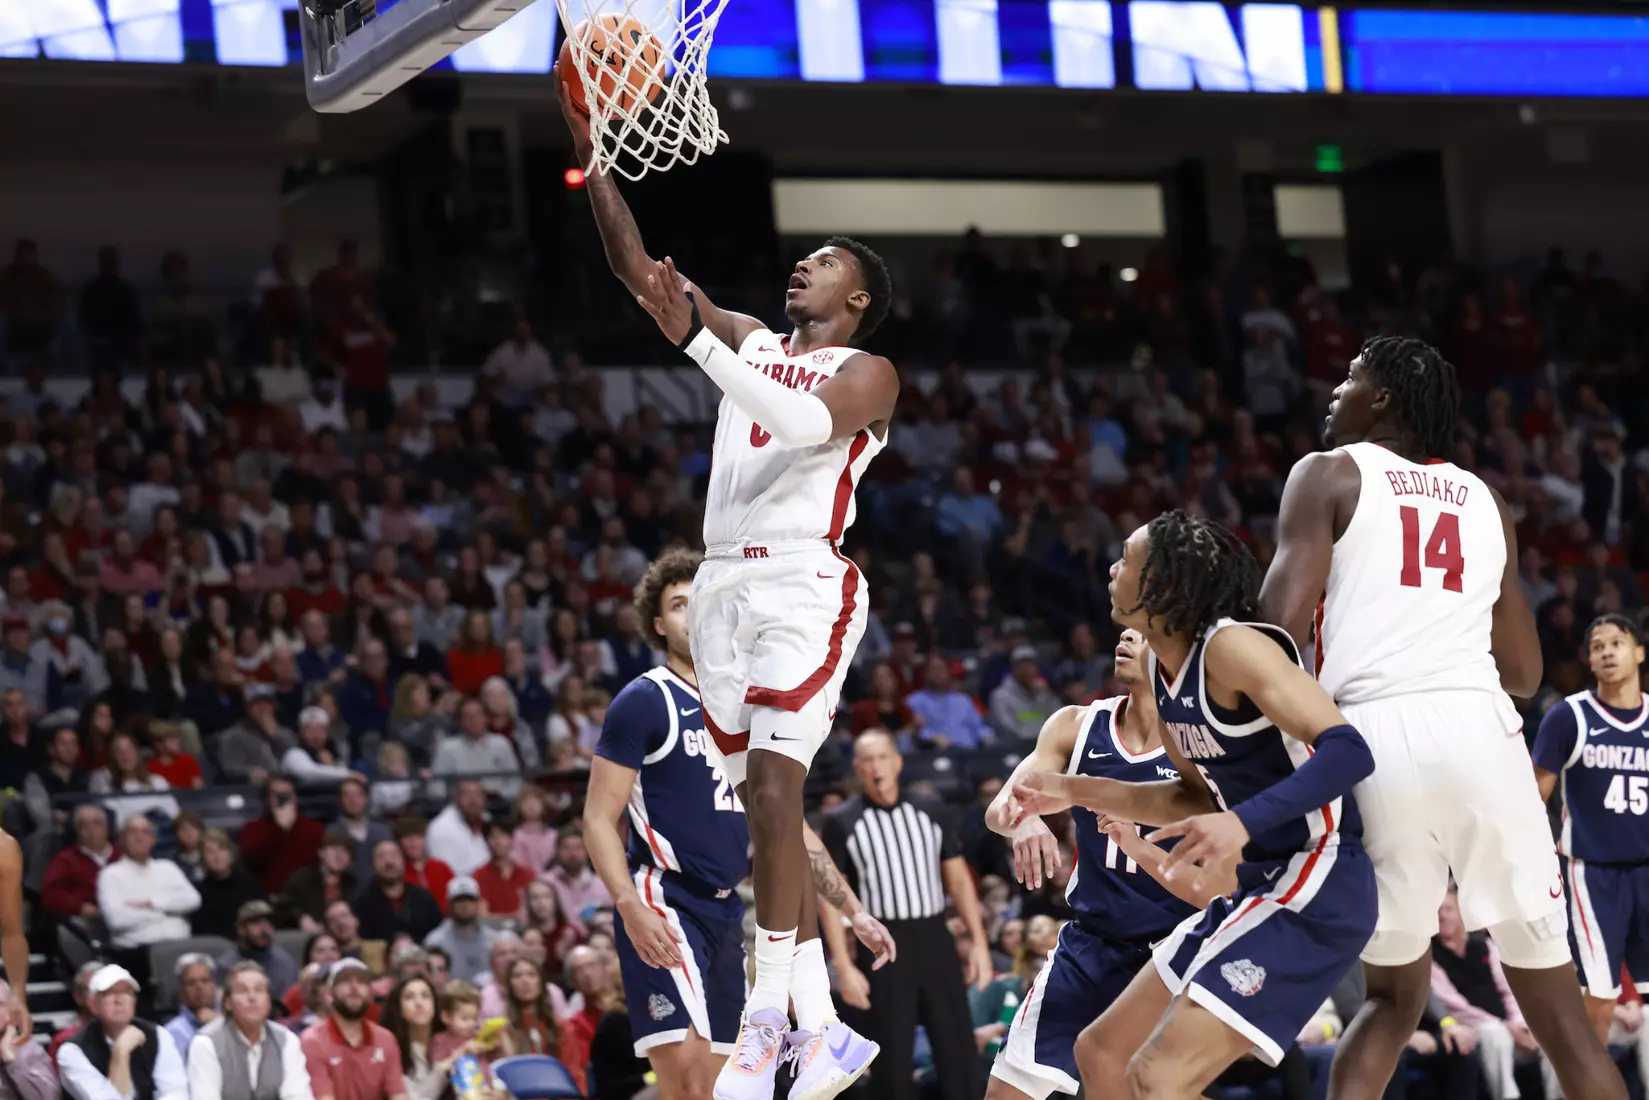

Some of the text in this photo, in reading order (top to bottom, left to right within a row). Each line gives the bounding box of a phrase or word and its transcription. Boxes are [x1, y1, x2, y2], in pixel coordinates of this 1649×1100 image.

[813, 352, 834, 364] SEC
[746, 360, 829, 392] ABAM
[1385, 470, 1468, 506] BEDIAKO
[743, 546, 769, 559] RTR
[1399, 505, 1464, 593] 14
[1155, 765, 1179, 779] WCC
[1583, 743, 1649, 772] GONZA
[1603, 774, 1649, 815] 45
